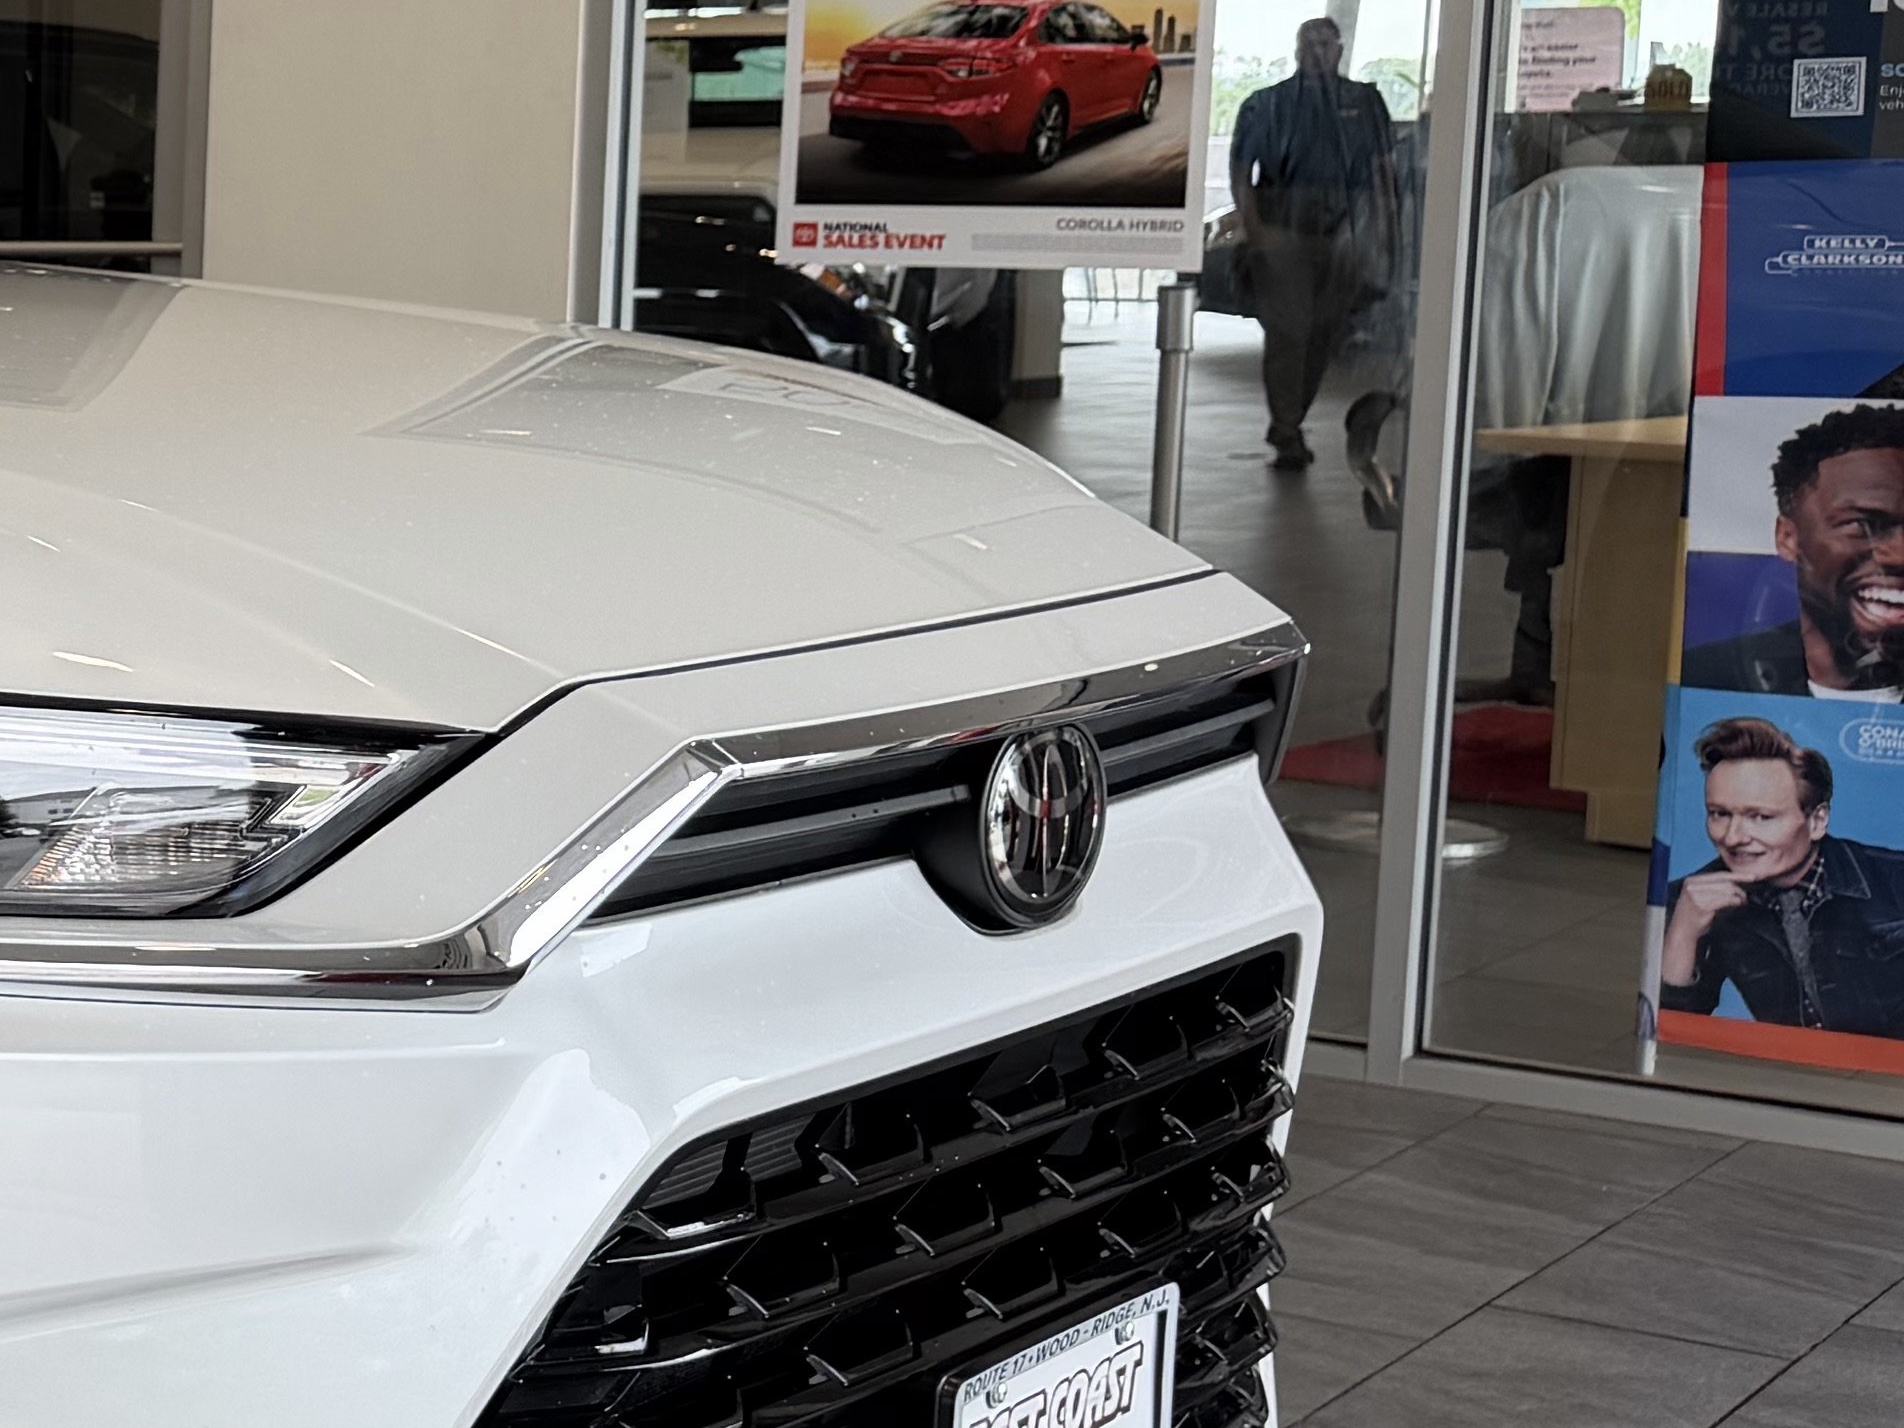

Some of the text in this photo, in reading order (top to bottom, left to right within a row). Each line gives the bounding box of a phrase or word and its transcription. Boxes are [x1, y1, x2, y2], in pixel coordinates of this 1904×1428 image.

[823, 222, 889, 233] NATIONAL
[1056, 217, 1184, 232] COROLLA HYBRID
[823, 233, 947, 250] SALES EVENT
[1814, 238, 1878, 248] KELLY
[1786, 254, 1904, 265] CLARKSON
[963, 1364, 1009, 1403] ROUTE
[1011, 1355, 1027, 1374] 17
[1141, 1288, 1170, 1313] N.J.
